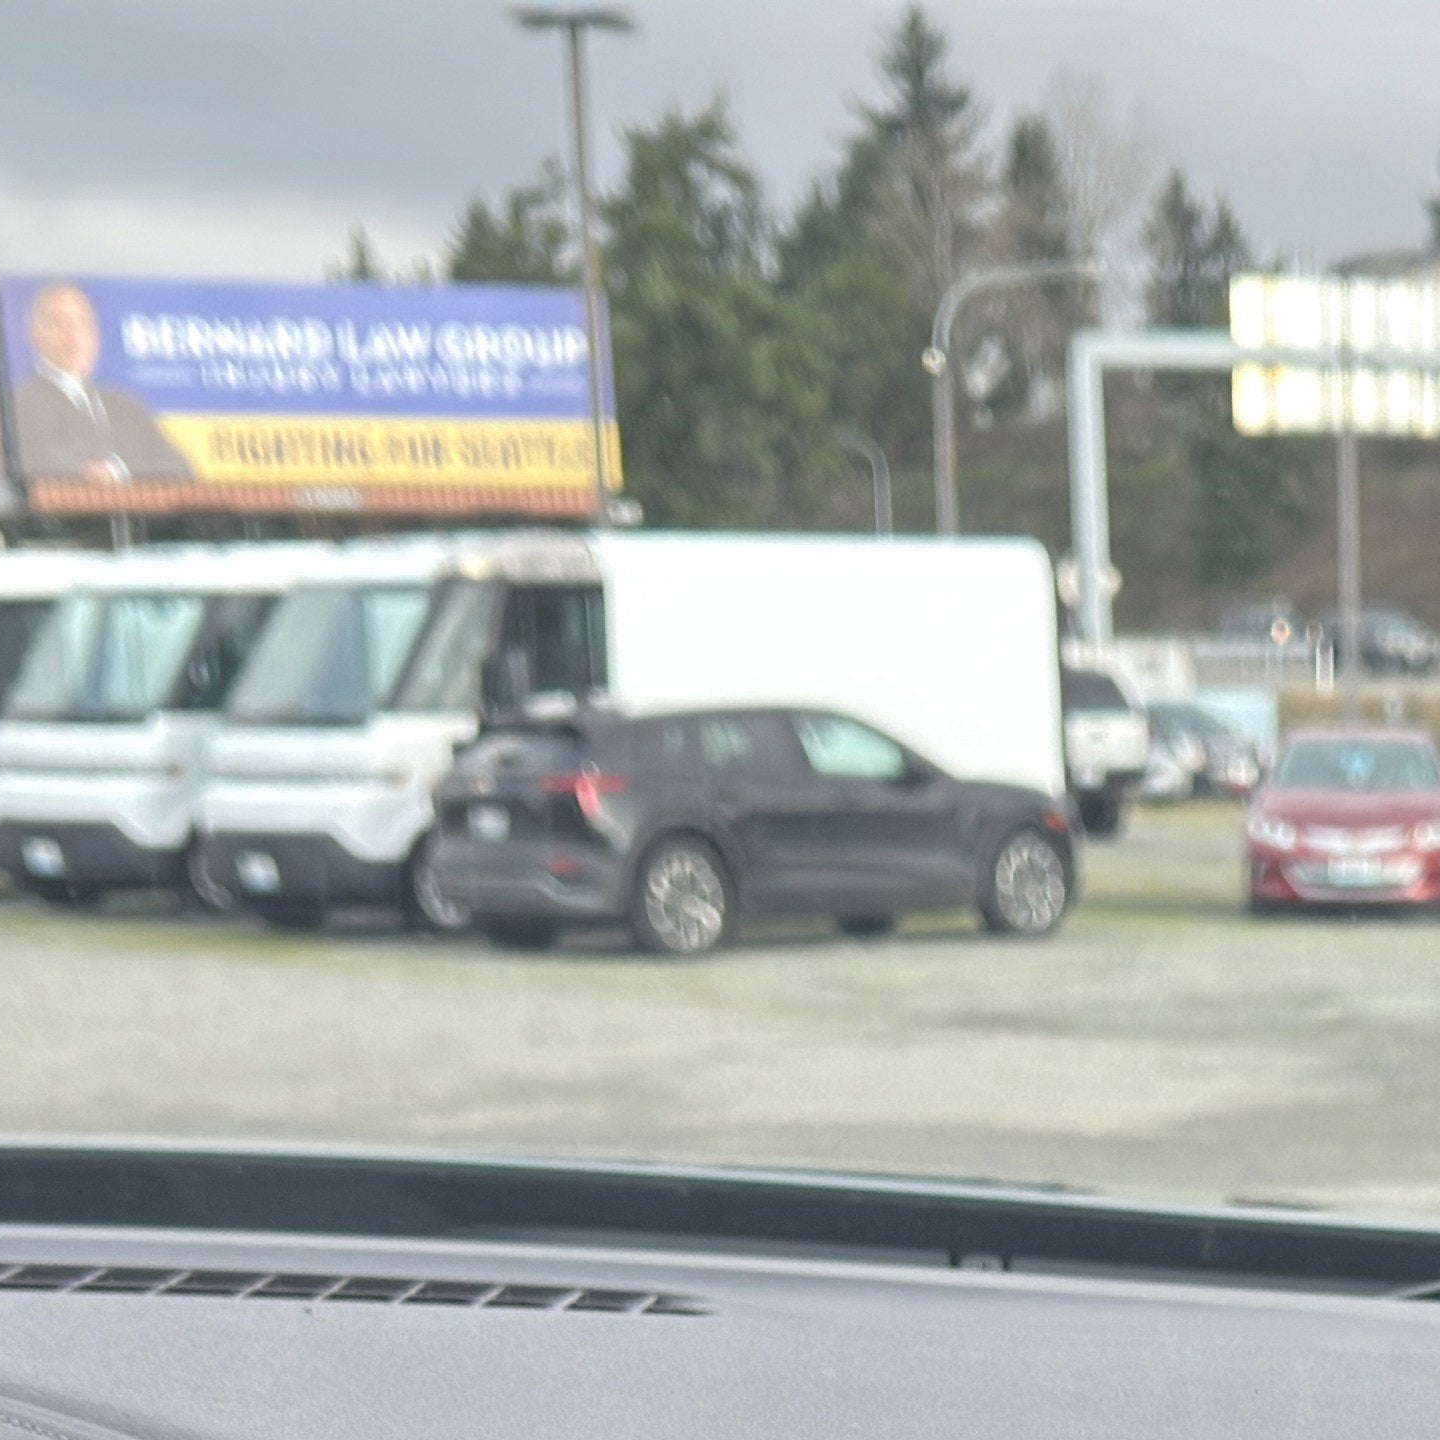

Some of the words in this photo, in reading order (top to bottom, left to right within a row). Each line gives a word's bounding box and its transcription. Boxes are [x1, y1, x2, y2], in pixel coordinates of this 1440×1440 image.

[121, 313, 333, 362] BERNARD
[335, 318, 432, 361] LAW
[434, 320, 589, 367] GROUP
